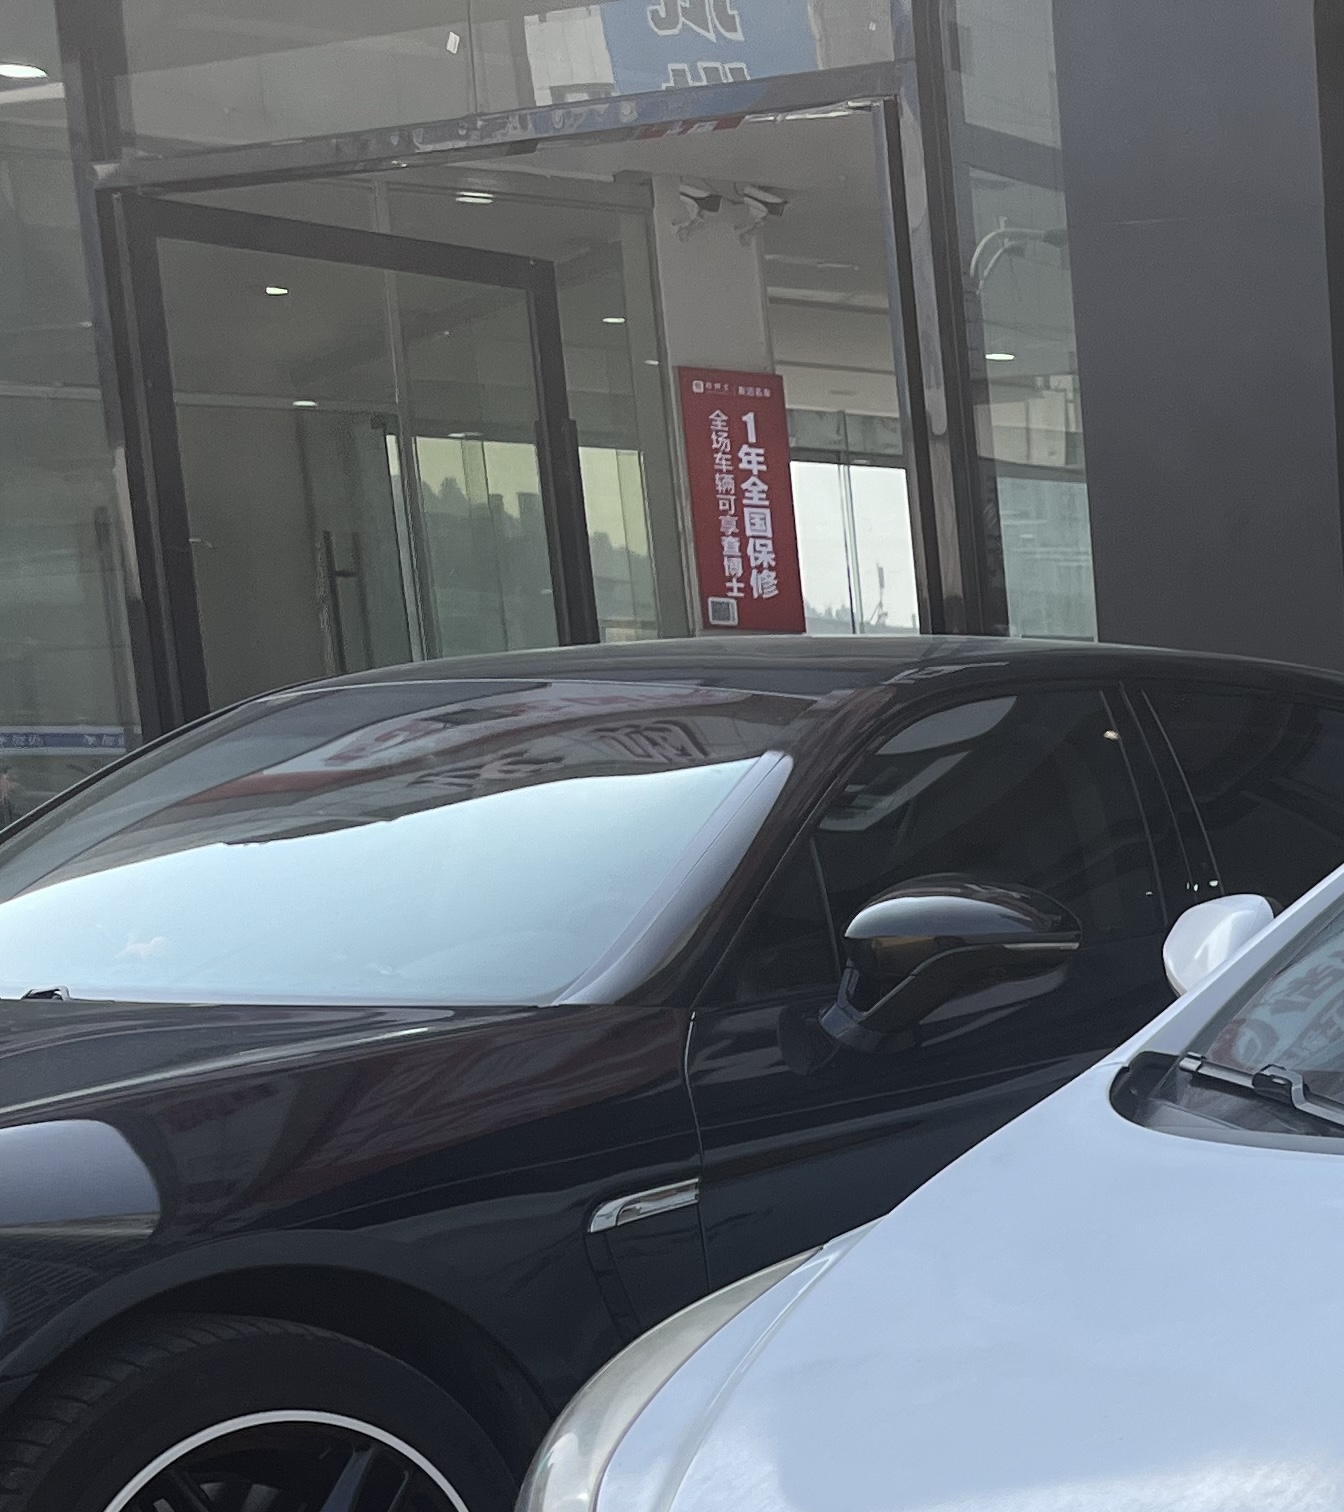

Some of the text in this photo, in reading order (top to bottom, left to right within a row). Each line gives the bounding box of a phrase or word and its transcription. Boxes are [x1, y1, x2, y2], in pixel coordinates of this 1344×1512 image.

[708, 409, 746, 598] 全场车辆可享查博士
[737, 411, 779, 600] 1年全国保修
